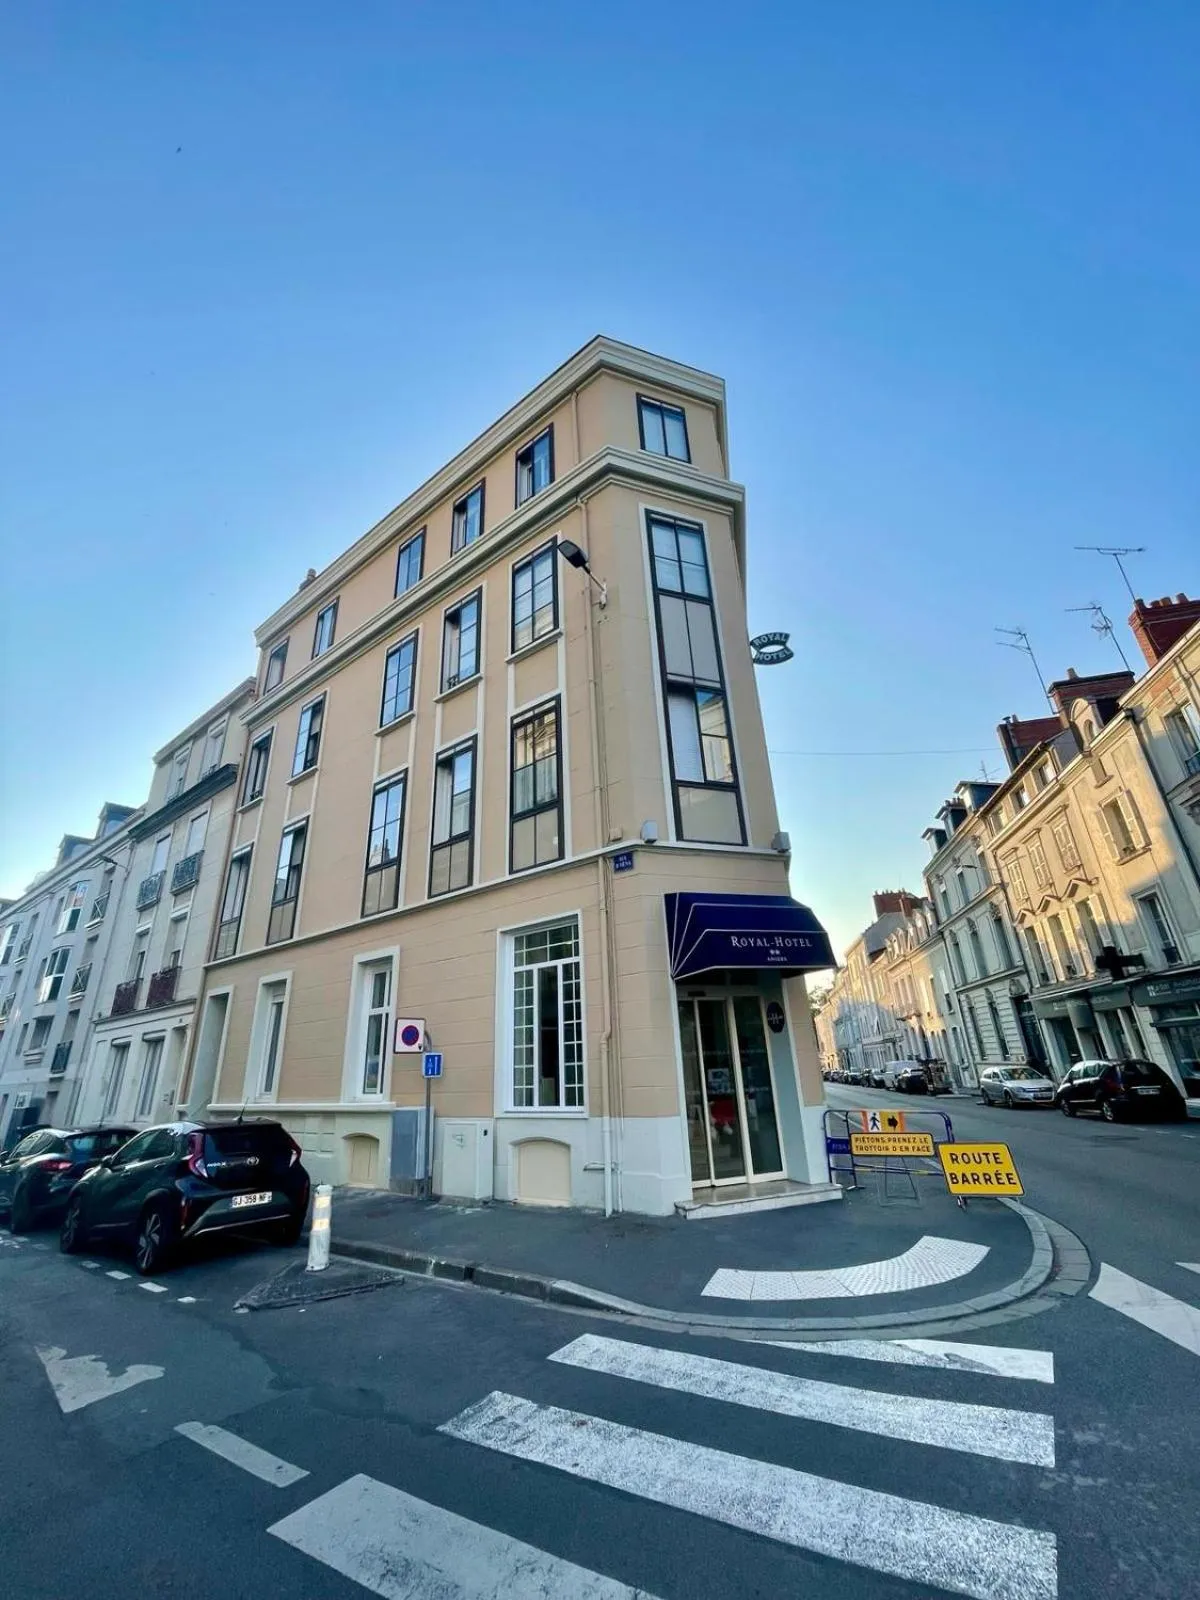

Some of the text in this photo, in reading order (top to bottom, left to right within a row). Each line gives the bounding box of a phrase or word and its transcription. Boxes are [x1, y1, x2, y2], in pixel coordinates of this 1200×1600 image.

[753, 633, 787, 645] ROYAL
[755, 649, 791, 661] HOTEL
[731, 935, 813, 948] ROYAL-HOTEL
[855, 1135, 929, 1144] PIÉTONS PRENEZ LE
[911, 1145, 931, 1153] FACE
[949, 1152, 1004, 1165] ROUTE
[949, 1170, 1017, 1185] BARRÉE
